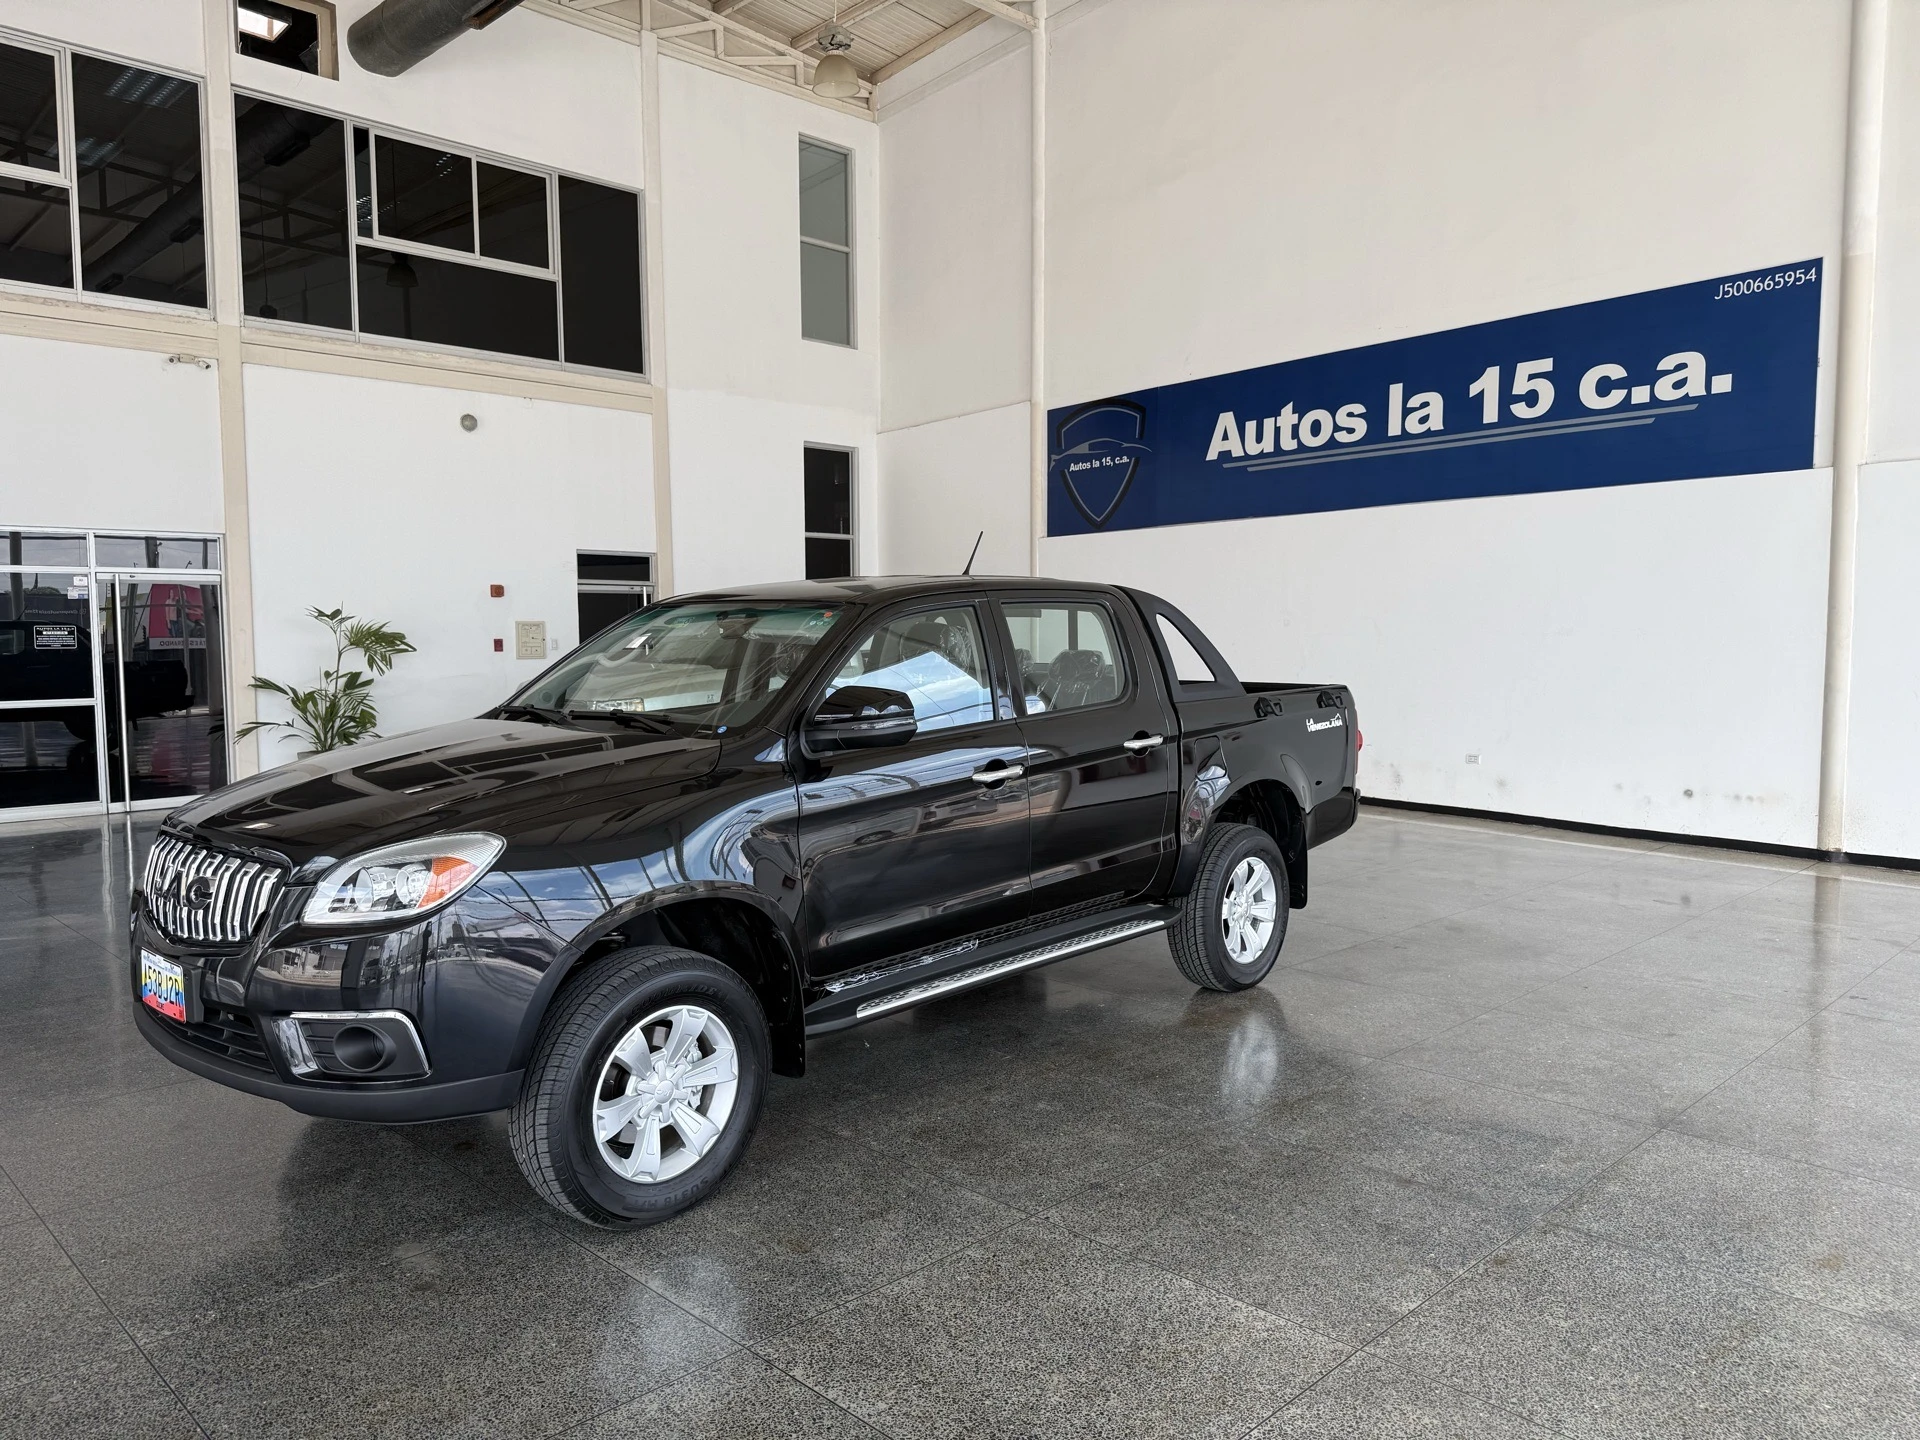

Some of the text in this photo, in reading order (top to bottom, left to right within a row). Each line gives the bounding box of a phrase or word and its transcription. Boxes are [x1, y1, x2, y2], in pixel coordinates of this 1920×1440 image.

[1714, 266, 1817, 300] J500665954
[1205, 349, 1733, 461] Autos la 15 c.a.
[1069, 462, 1091, 472] Autos
[1092, 459, 1100, 468] la
[1115, 455, 1130, 464] c.a.
[143, 963, 182, 1008] A53BJ2R
